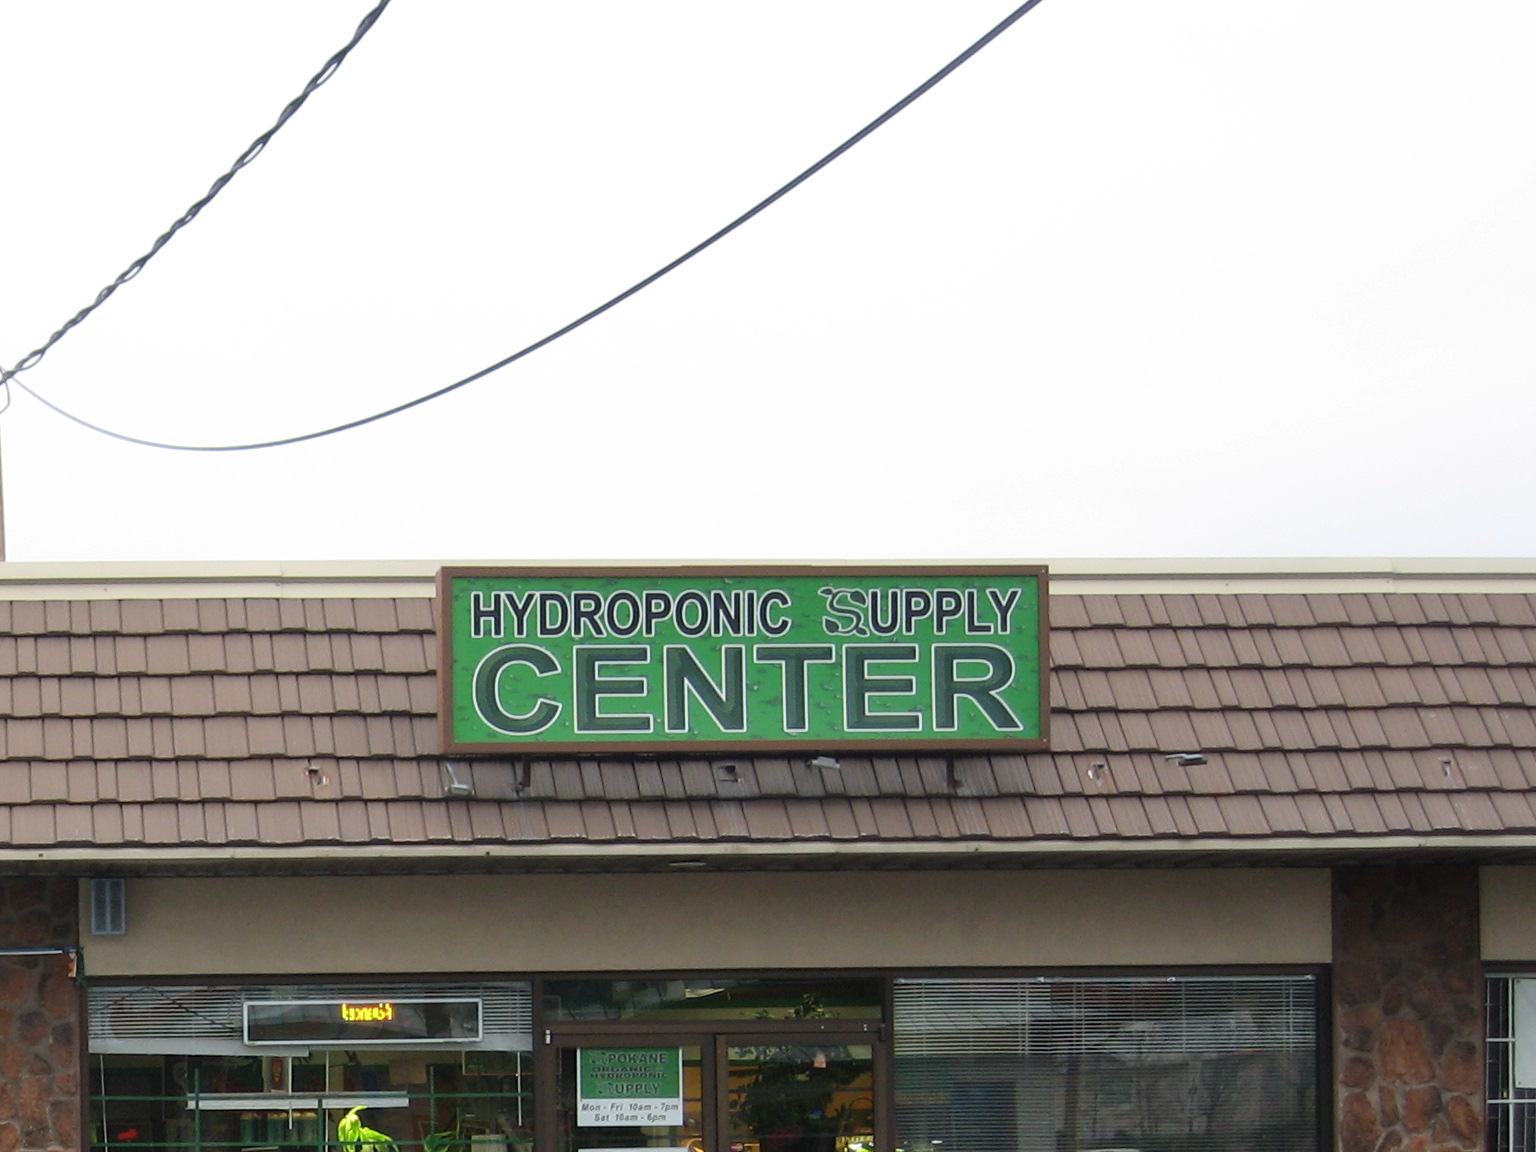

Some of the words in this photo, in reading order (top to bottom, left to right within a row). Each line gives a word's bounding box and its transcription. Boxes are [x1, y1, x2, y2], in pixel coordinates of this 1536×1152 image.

[470, 588, 792, 638] HYDROPONIC
[818, 586, 1022, 636] SUPPLY
[472, 642, 1025, 735] CENTER
[581, 1103, 601, 1111] Mon
[609, 1102, 624, 1111] Fri
[594, 1113, 610, 1122] Sat
